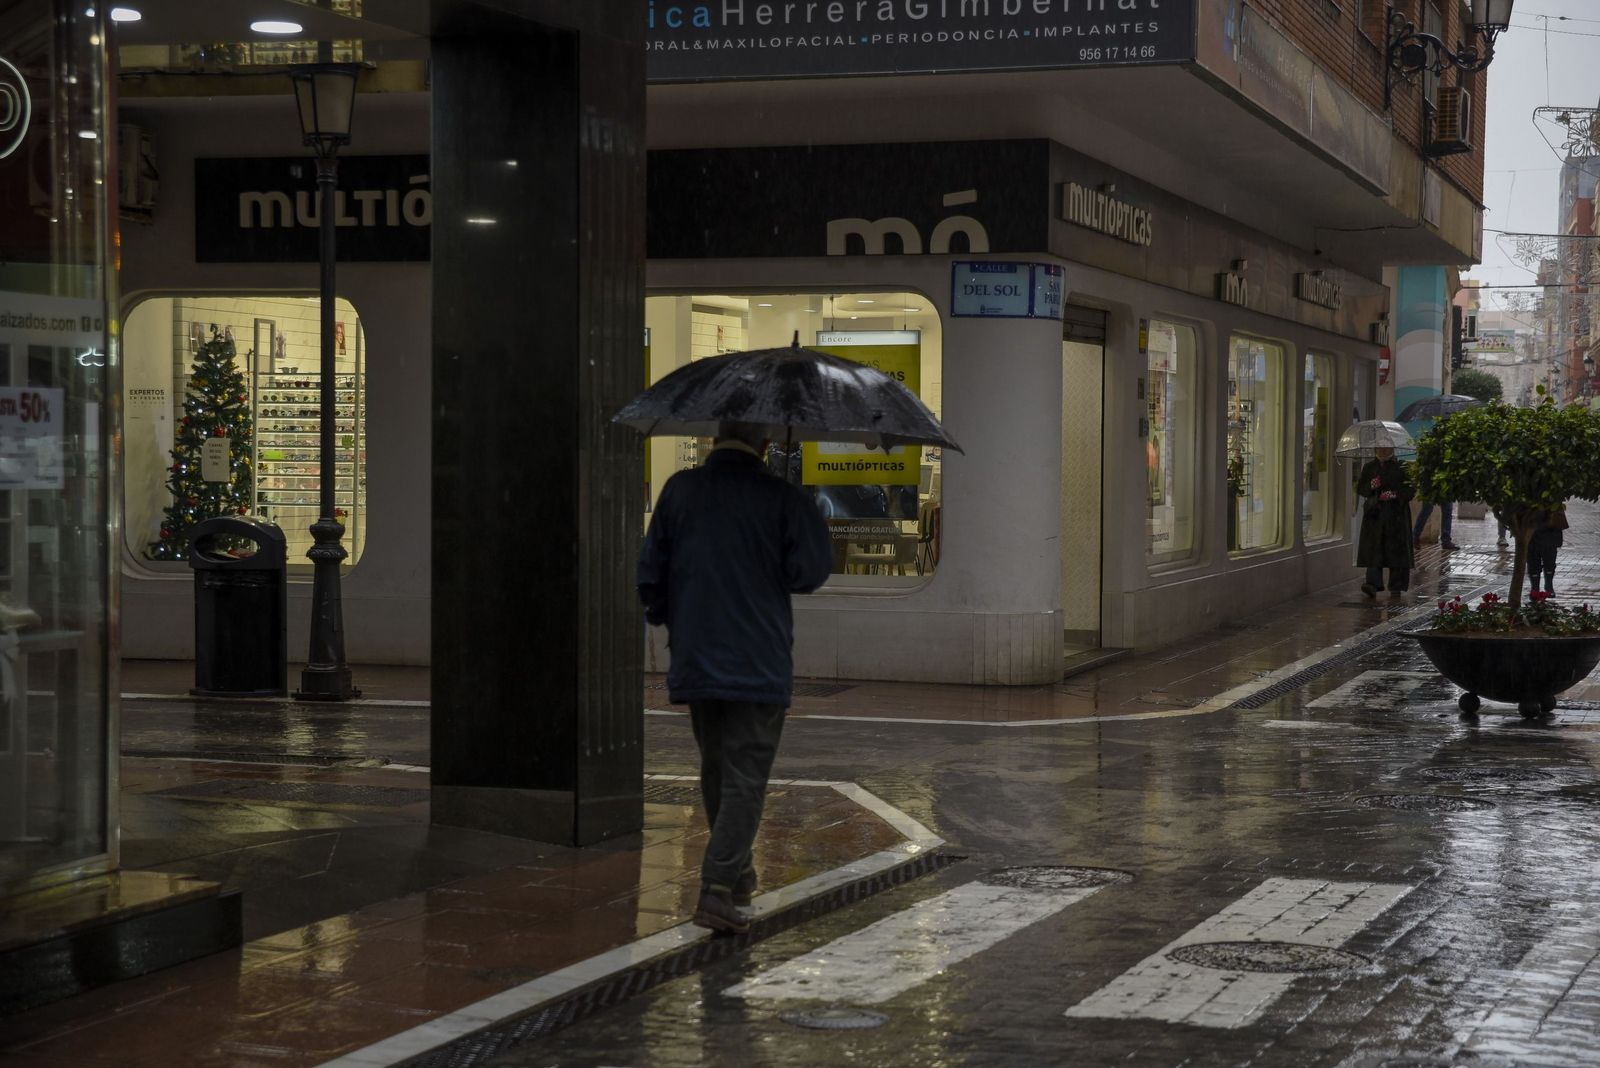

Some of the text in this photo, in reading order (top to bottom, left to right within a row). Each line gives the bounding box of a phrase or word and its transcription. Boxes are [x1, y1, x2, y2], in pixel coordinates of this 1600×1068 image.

[872, 31, 1019, 45] PERIODONCIA
[1035, 21, 1159, 38] IMPLANTES
[1079, 45, 1156, 61] 956 17 14 66
[979, 264, 1008, 272] CALLE
[963, 284, 1021, 297] DEL SOL
[821, 335, 852, 343] Encore
